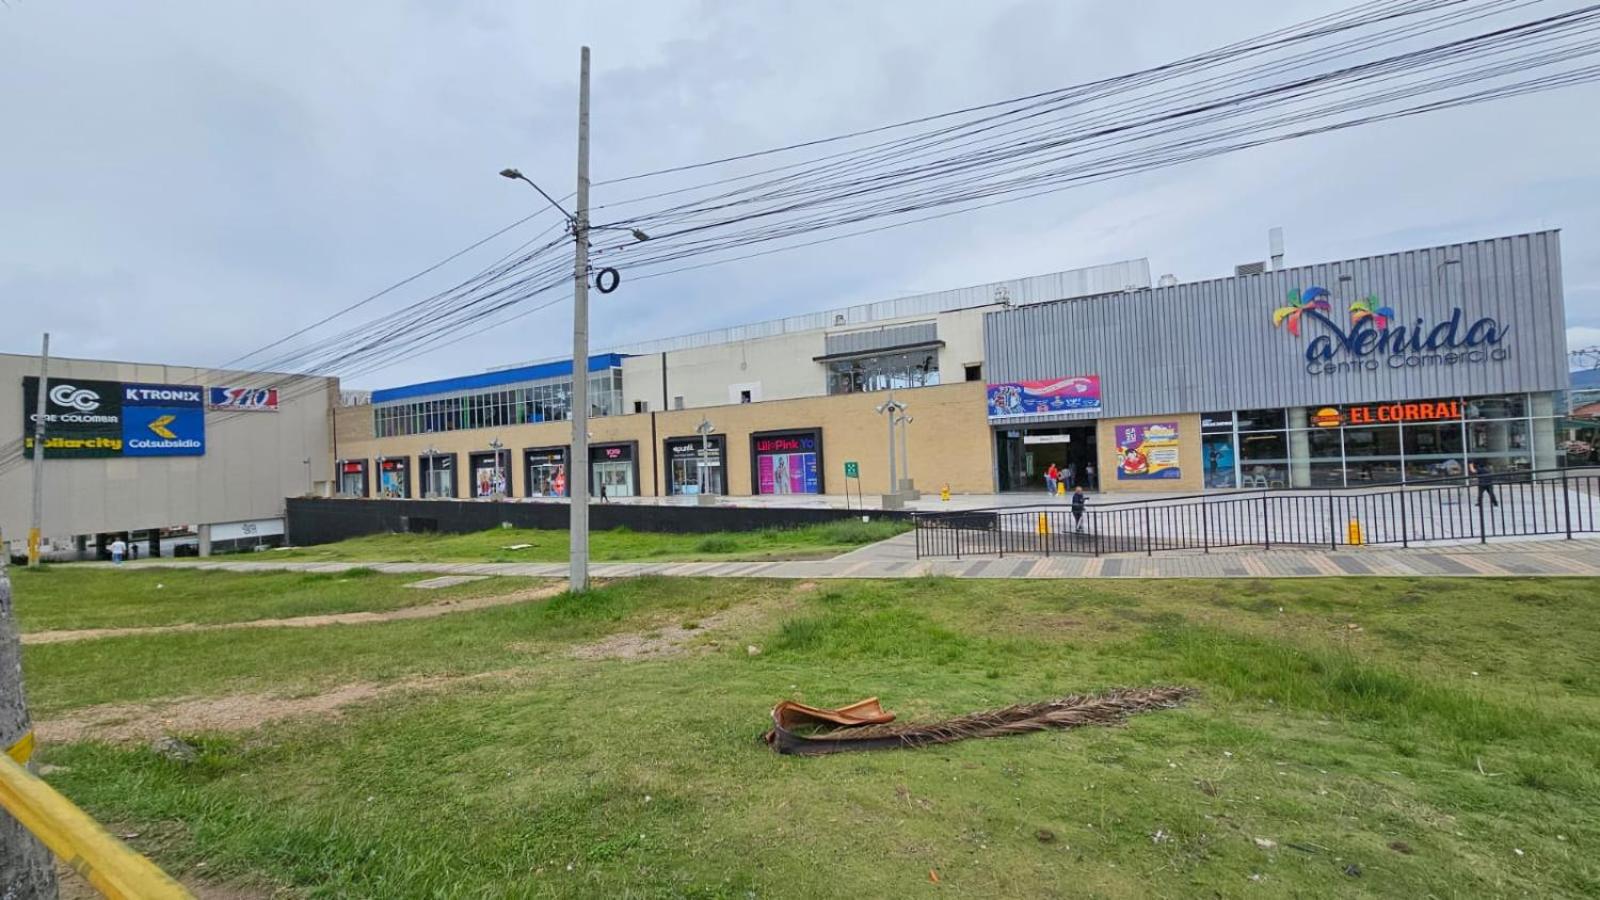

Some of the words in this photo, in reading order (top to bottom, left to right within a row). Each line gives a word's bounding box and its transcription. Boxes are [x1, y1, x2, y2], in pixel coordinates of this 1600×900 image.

[1306, 358, 1379, 376] Centro
[1387, 344, 1512, 369] Comercial
[30, 414, 57, 422] CNE
[60, 415, 119, 423] COLOMBIA
[1351, 407, 1375, 423] EL
[1377, 401, 1462, 422] CORRAL
[129, 439, 202, 449] Colsubsidio
